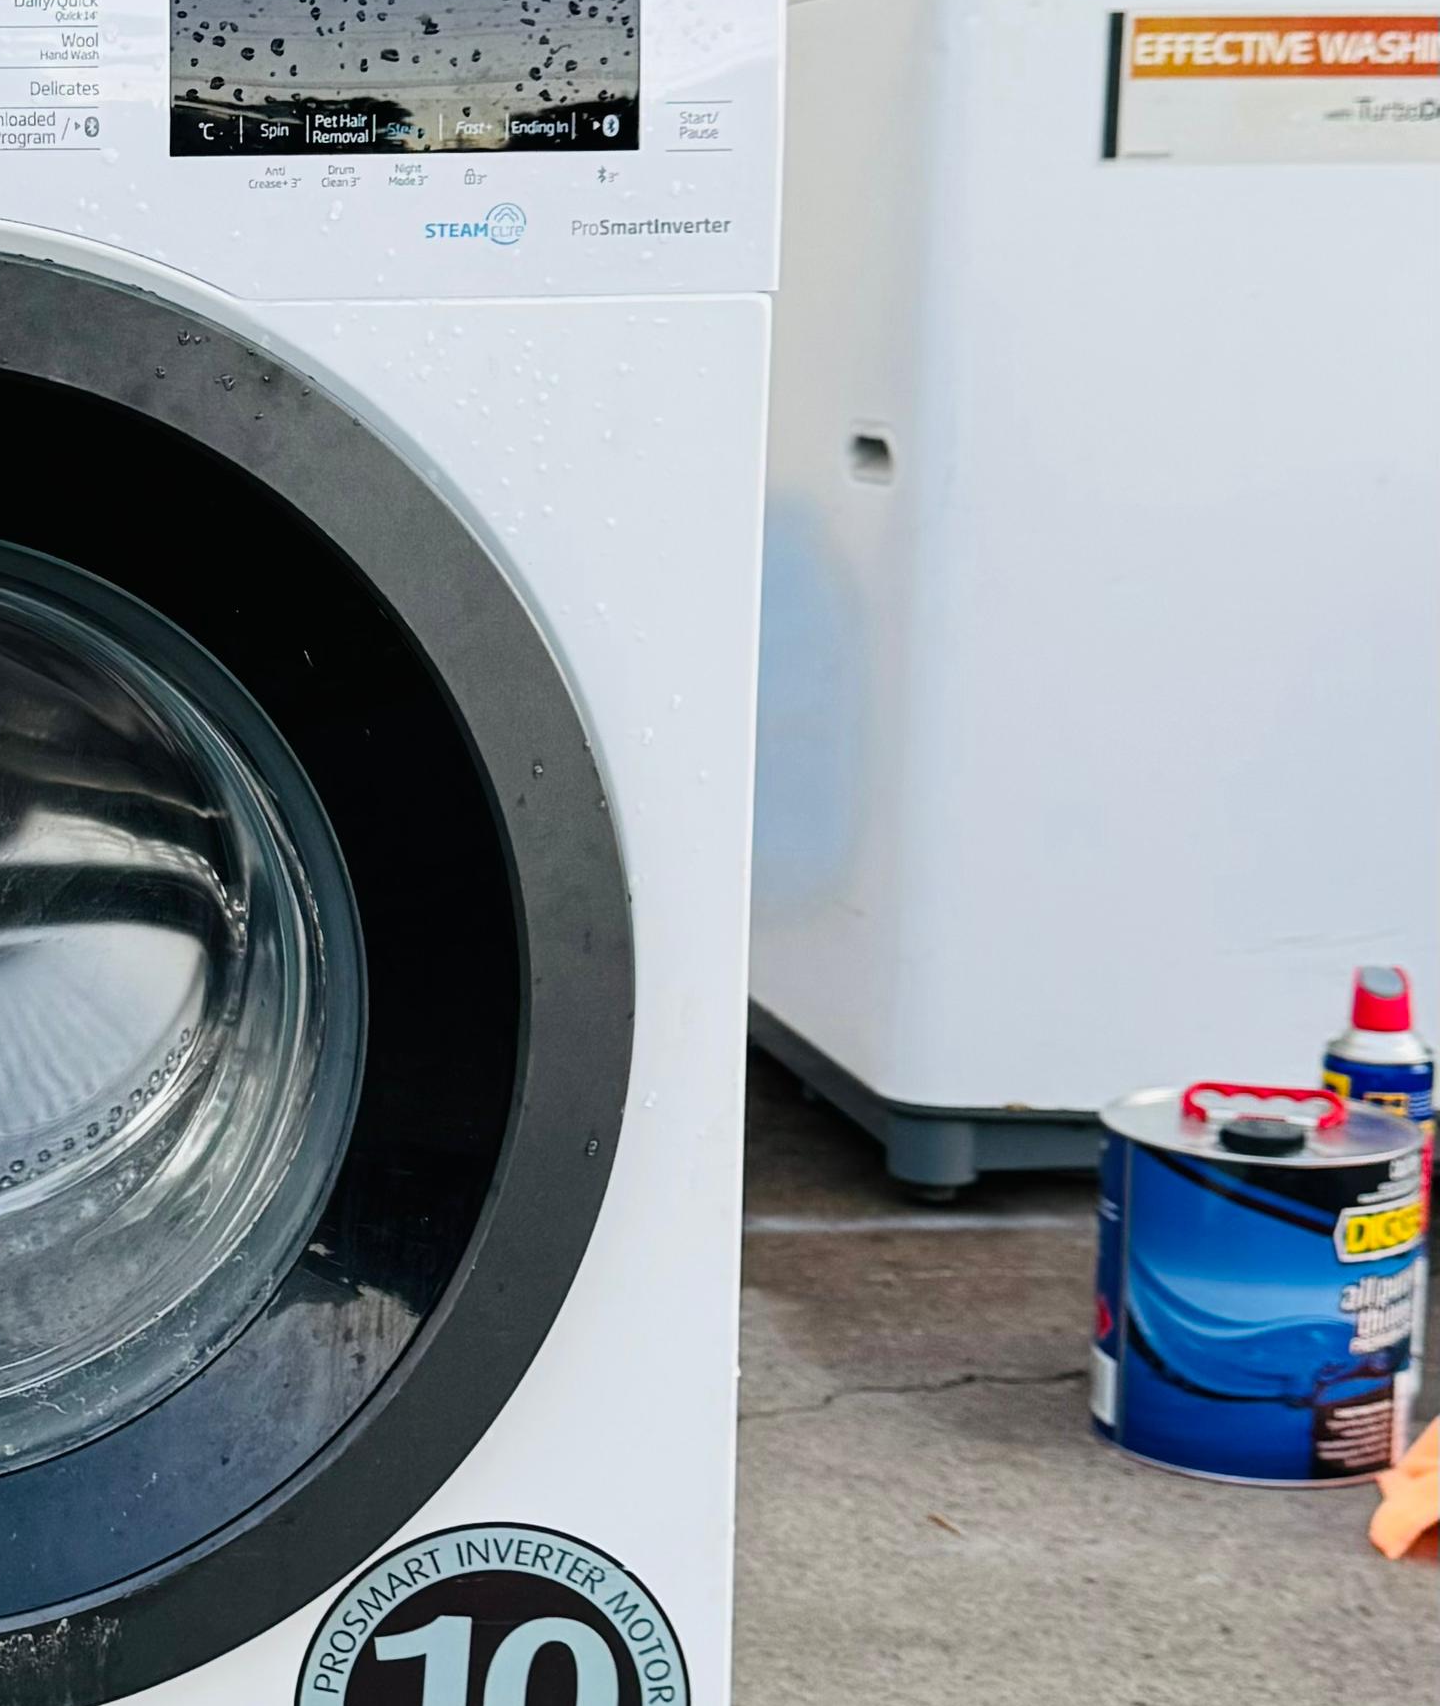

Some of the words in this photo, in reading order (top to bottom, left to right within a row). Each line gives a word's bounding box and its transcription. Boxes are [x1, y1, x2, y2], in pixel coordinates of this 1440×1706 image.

[54, 10, 82, 23] Quick
[61, 31, 100, 49] Wool
[39, 50, 69, 61] Hand
[71, 50, 100, 61] Wash
[1133, 31, 1316, 66] EFFECTIVE
[29, 80, 101, 97] Delicates
[314, 114, 337, 129] Pet
[339, 113, 368, 128] Hair
[511, 120, 554, 136] Ending
[556, 120, 569, 134] In
[260, 123, 289, 139] Spin
[312, 129, 369, 144] Removal
[679, 126, 720, 141] Pause
[265, 166, 286, 176] Anti
[327, 164, 355, 176] Drum
[394, 163, 422, 176] Night
[248, 178, 289, 189] Crease+
[320, 176, 348, 188] Clean
[388, 176, 416, 187] Mode
[571, 217, 732, 237] ProSmartInverter
[313, 1548, 443, 1695] PROSMART
[455, 1537, 606, 1596] INVERTER
[604, 1590, 676, 1705] MOTOR
